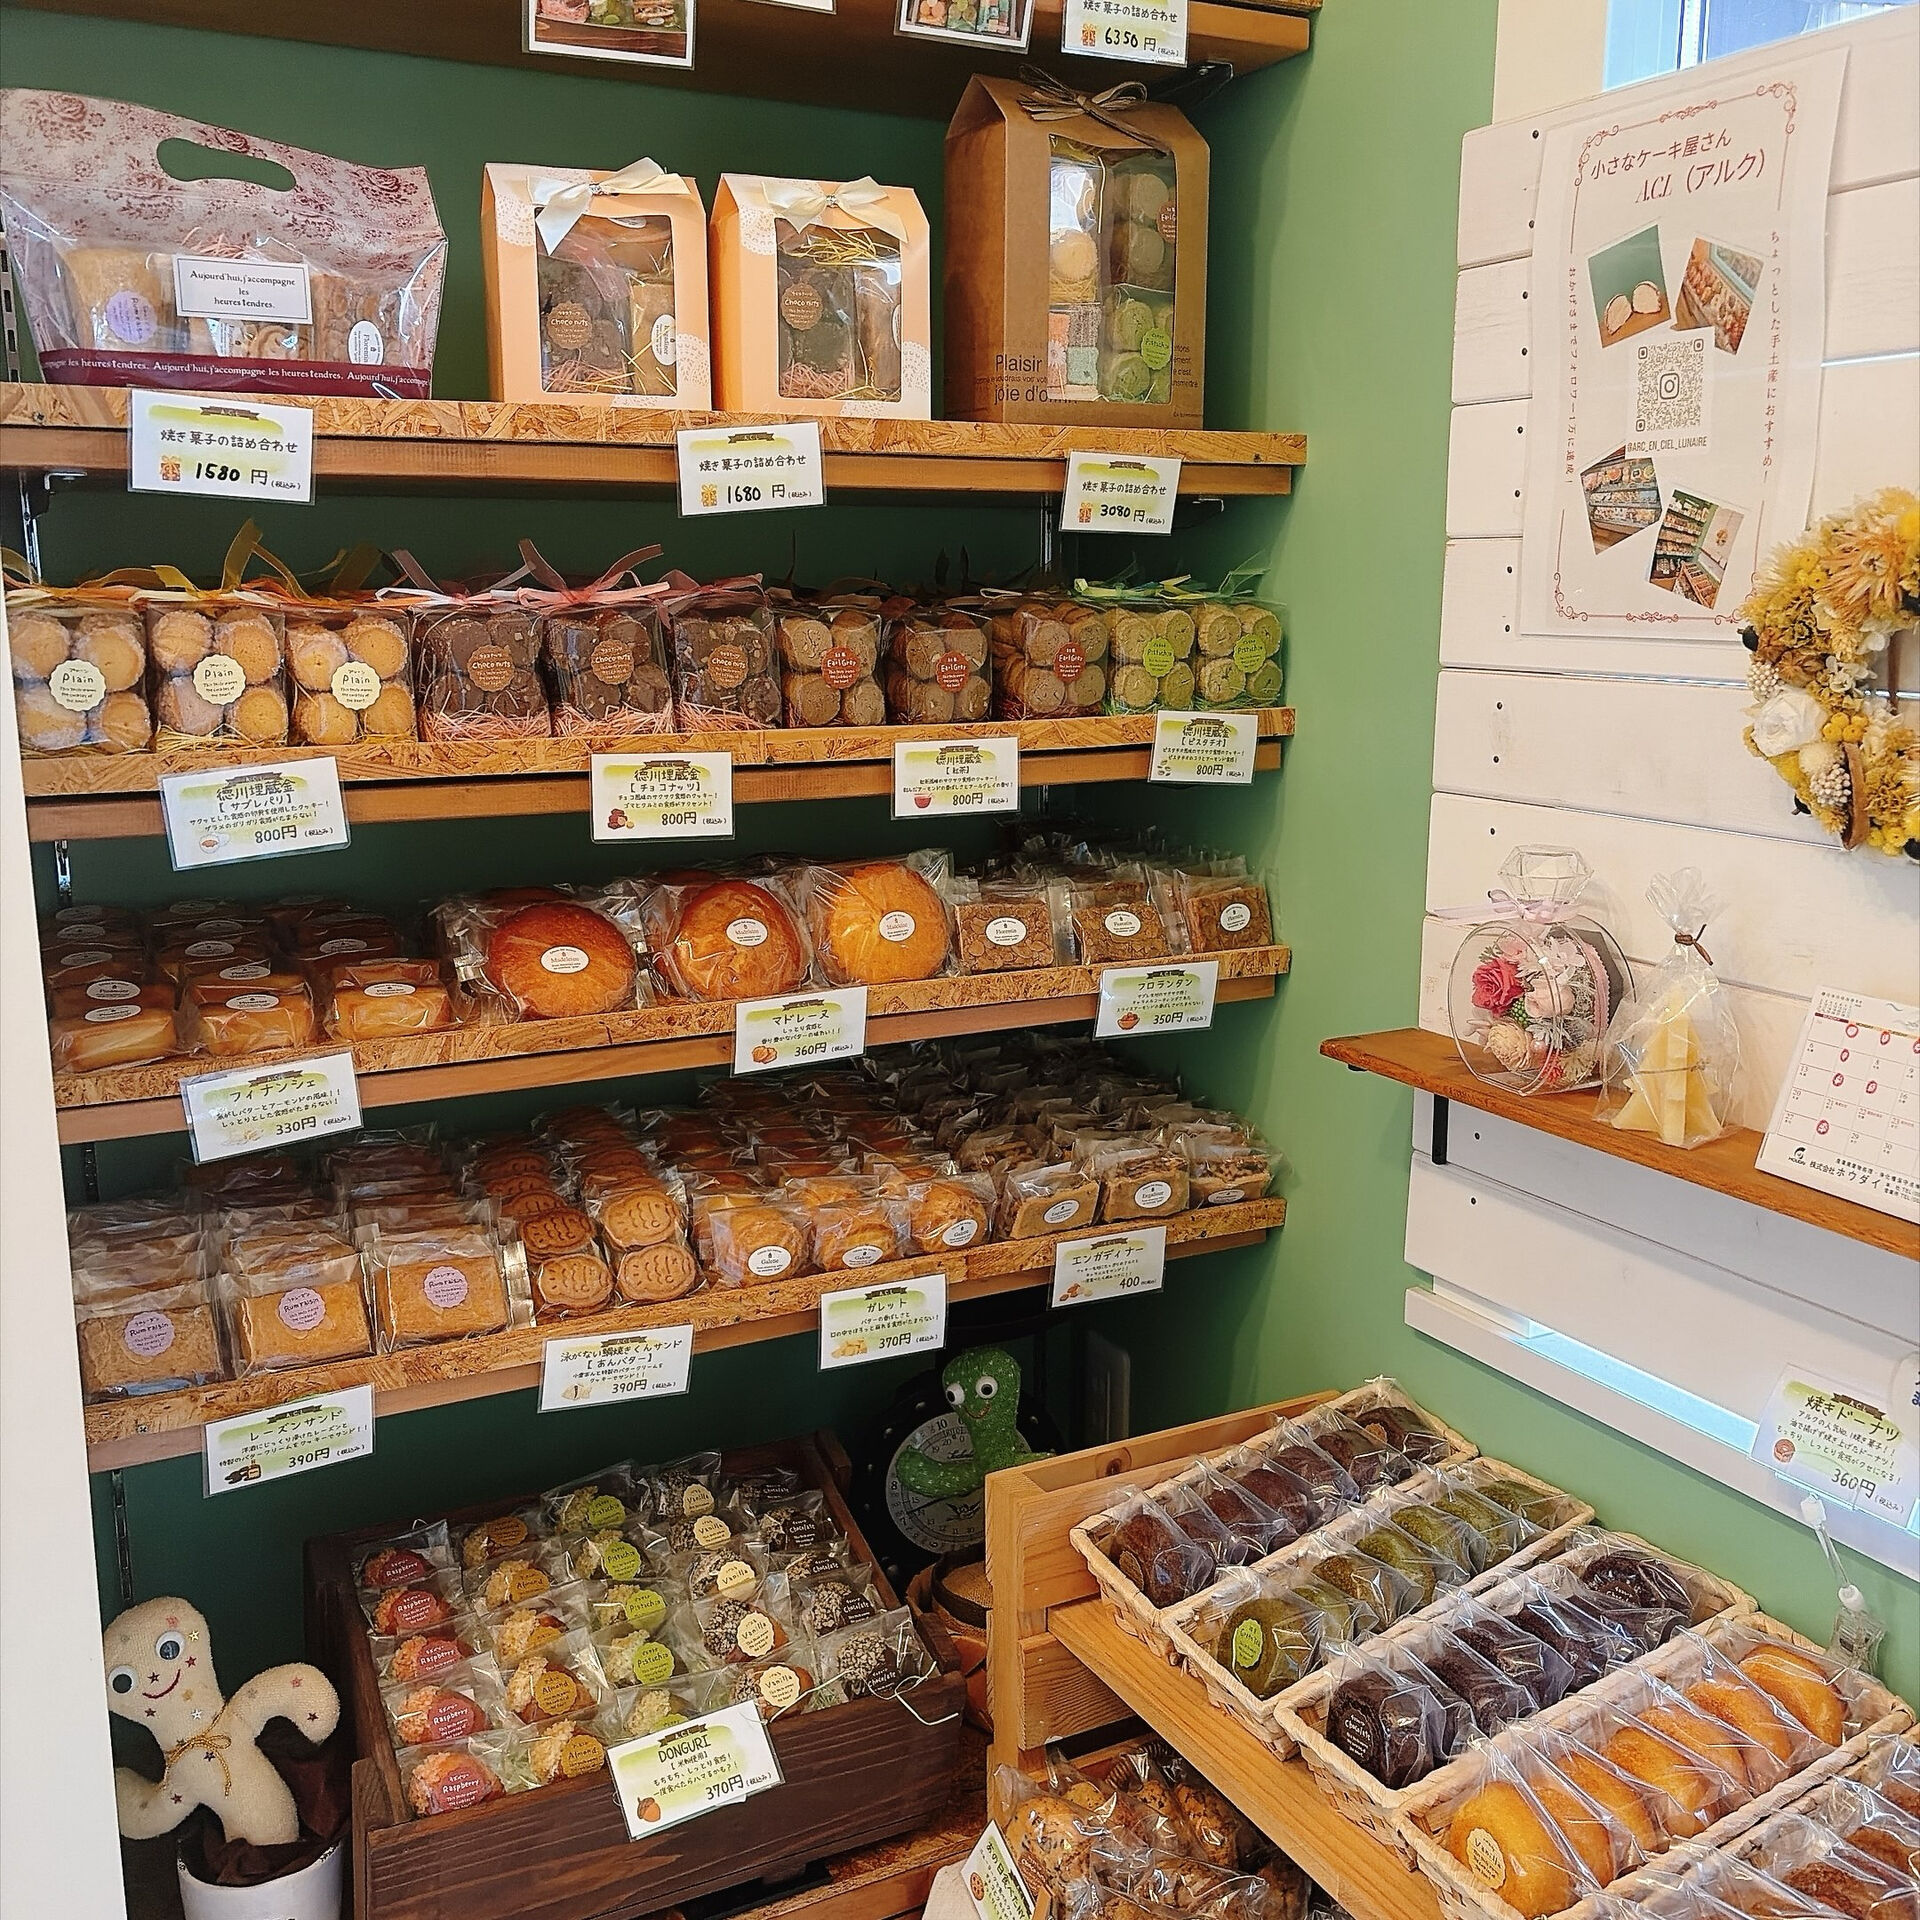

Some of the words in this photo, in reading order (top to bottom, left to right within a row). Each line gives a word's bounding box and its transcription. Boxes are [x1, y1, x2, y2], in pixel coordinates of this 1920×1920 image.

[1105, 27, 1138, 48] 6350
[1591, 128, 1731, 179] 小さなケーキ屋さん
[238, 288, 249, 296] les
[995, 354, 1042, 373] Plaisir
[994, 385, 1021, 405] joie
[160, 429, 298, 453] 焼き菓子の詰め合わせ
[195, 463, 240, 481] 1580
[699, 455, 806, 472] 焼き菓子の詰め合わせ
[728, 485, 761, 504] 1680
[1082, 480, 1167, 495] 焼き菓子の詰め合わせ
[1100, 504, 1131, 518] 3080
[62, 673, 94, 684] Plain
[204, 670, 233, 679] Plain
[343, 674, 370, 684] Plain
[634, 768, 701, 782] 徳川埋蔵金
[1196, 764, 1224, 776] 800円
[216, 779, 296, 801] 徳川埋蔵金
[952, 792, 984, 806] 800円
[661, 811, 697, 826] 800円
[255, 824, 297, 844] 800円
[1138, 979, 1193, 991] フロランタン
[772, 1009, 830, 1026] マドレーヌ
[1153, 1012, 1183, 1025] 350円
[795, 1042, 826, 1057] 360円
[230, 1078, 316, 1102] フィナンシェ
[275, 1116, 316, 1136] 330円
[1809, 1160, 1881, 1189] 株式会社ホウダイ
[1071, 1246, 1144, 1266] エンガディナー
[1119, 1276, 1140, 1289] 400
[866, 1298, 907, 1313] ガレット
[878, 1332, 912, 1349] 370円
[611, 1379, 648, 1394] 390円
[250, 1410, 344, 1442] レーズンサンド
[1805, 1395, 1899, 1441] 焼きドーナツ
[288, 1447, 330, 1468] 390円
[698, 1523, 724, 1536] Vanilla
[722, 1568, 748, 1585] Vanilla
[397, 1596, 431, 1612] Raspberry
[742, 1620, 767, 1640] Vanilla
[420, 1648, 454, 1666] Raspberry
[542, 1681, 570, 1696] Almond
[764, 1673, 793, 1691] Vanilla
[432, 1706, 469, 1725] Raspberry
[568, 1747, 597, 1761] Almond
[658, 1734, 712, 1763] DONGURI
[441, 1776, 480, 1795] Raspberry
[705, 1774, 744, 1801] 370円
